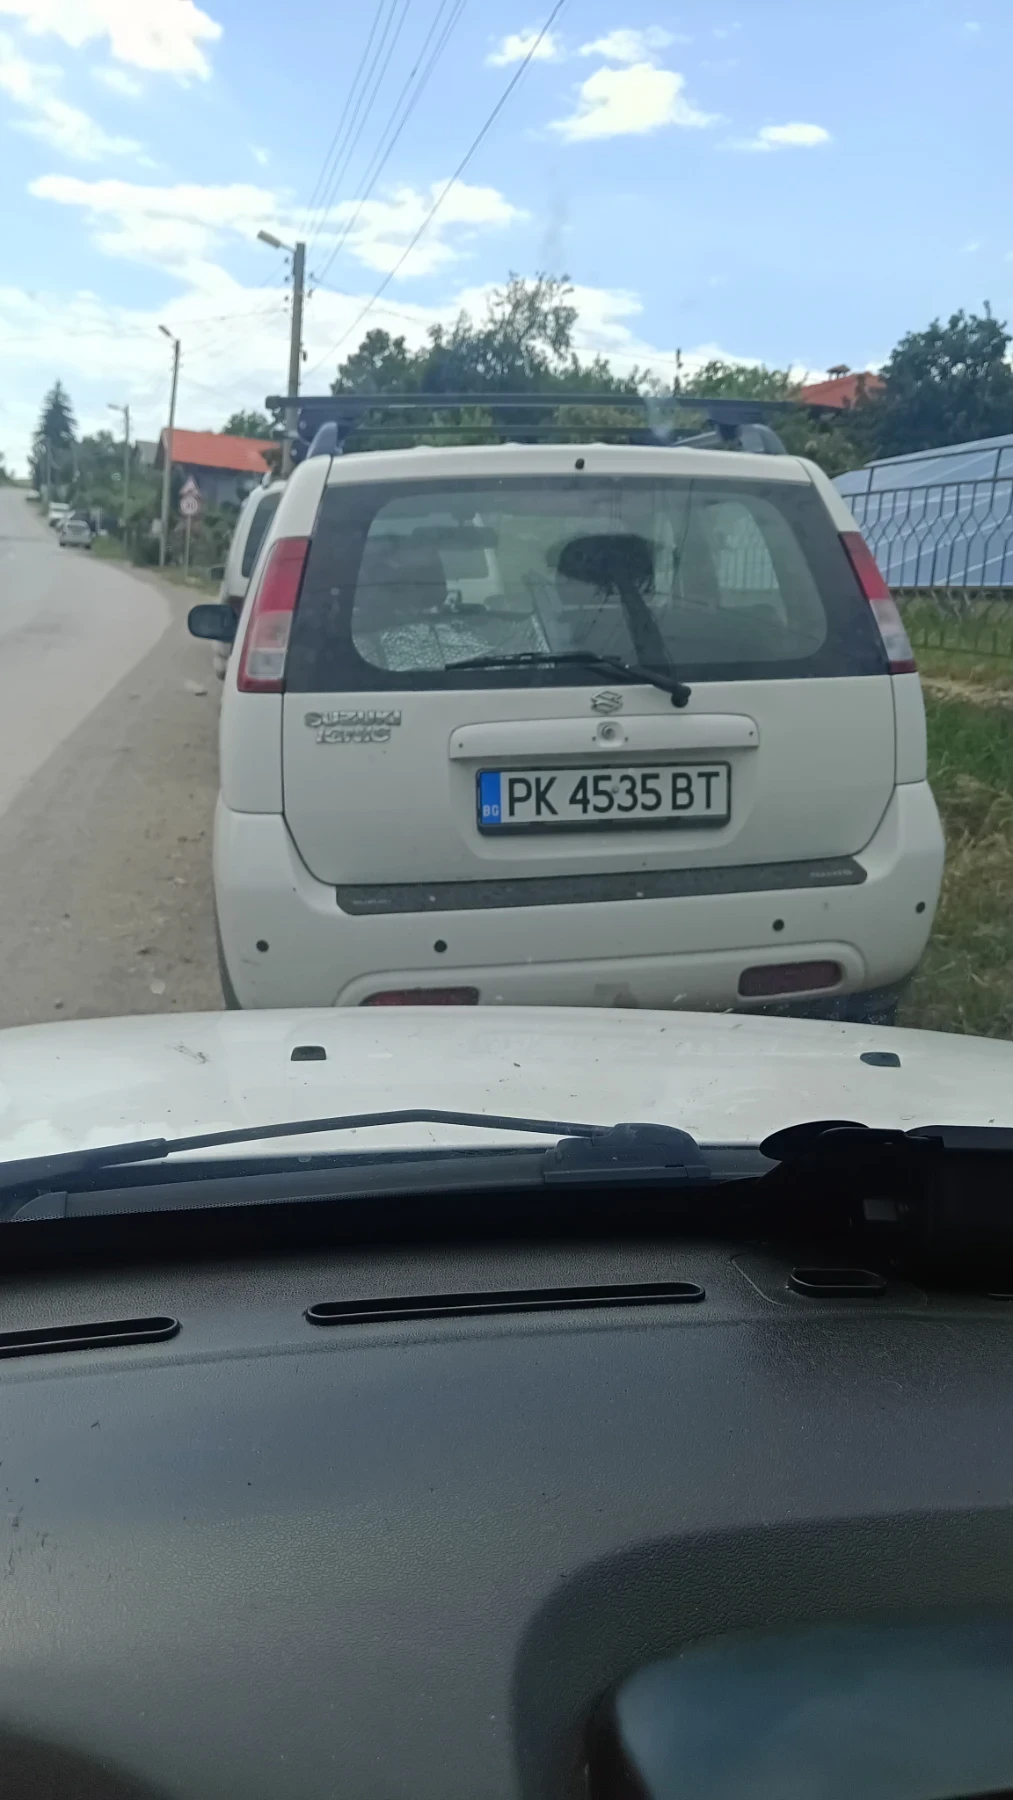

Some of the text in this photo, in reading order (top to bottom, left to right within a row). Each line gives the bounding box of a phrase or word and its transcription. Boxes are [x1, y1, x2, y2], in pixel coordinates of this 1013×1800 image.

[304, 710, 402, 728] SUZUKI
[508, 771, 720, 817] PK 4535 BT
[483, 804, 499, 817] BG
